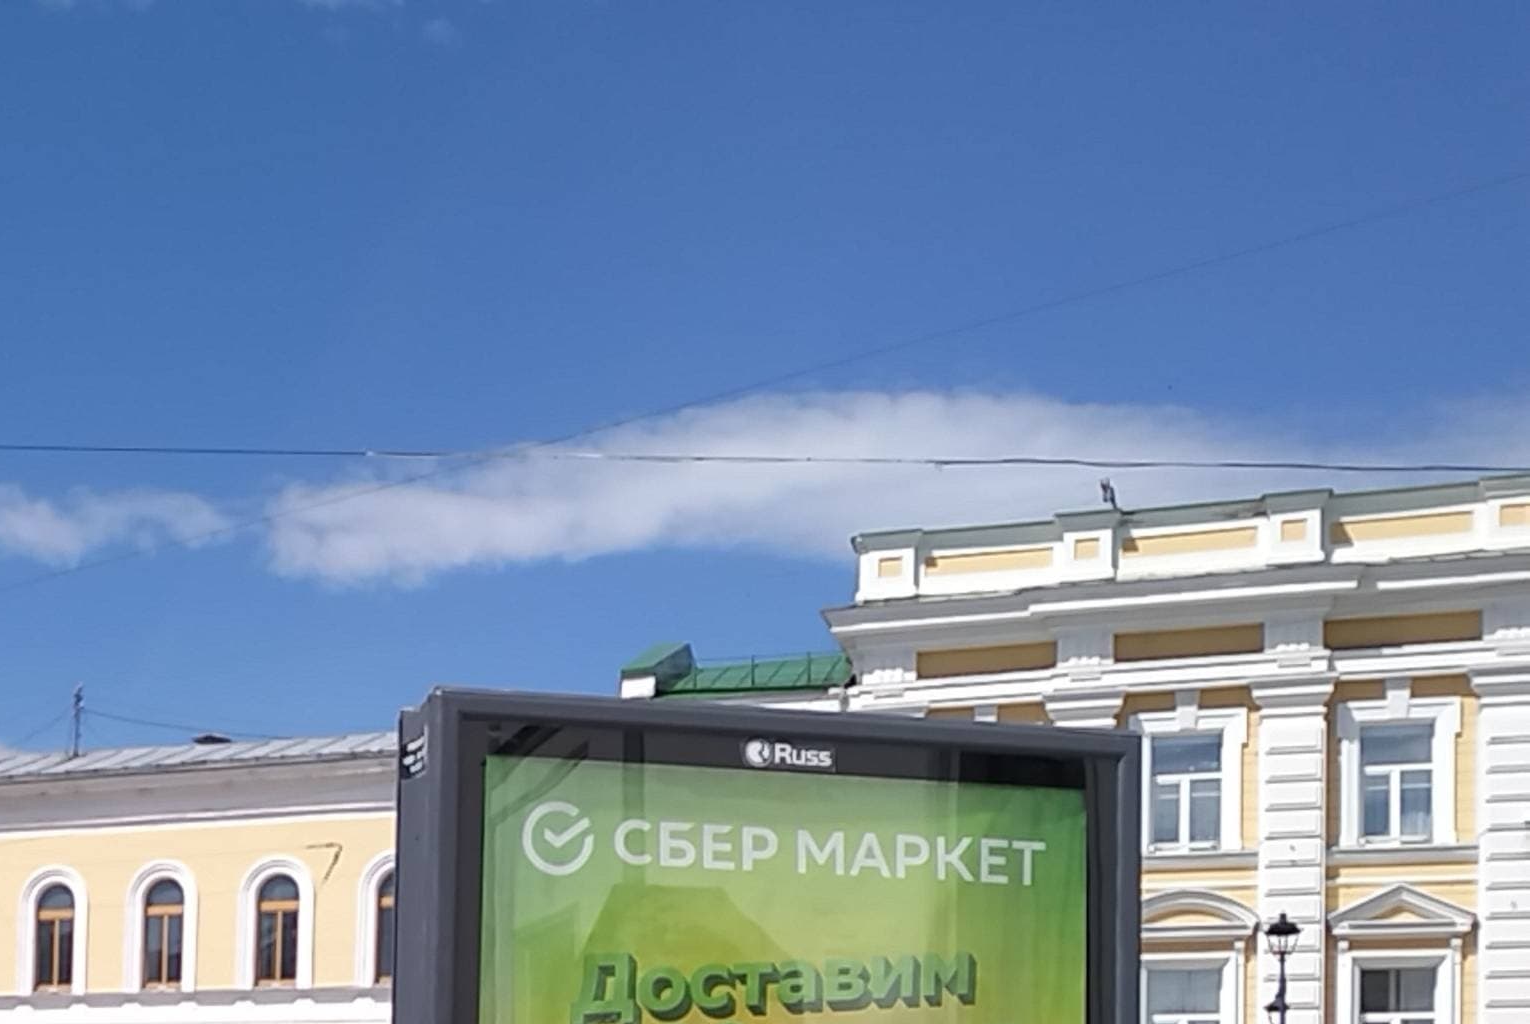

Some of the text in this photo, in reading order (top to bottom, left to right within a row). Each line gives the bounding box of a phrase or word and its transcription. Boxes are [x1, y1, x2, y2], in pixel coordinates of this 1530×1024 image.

[774, 742, 833, 767] Russ
[613, 818, 1047, 886] СБЕР МАРКЕТ
